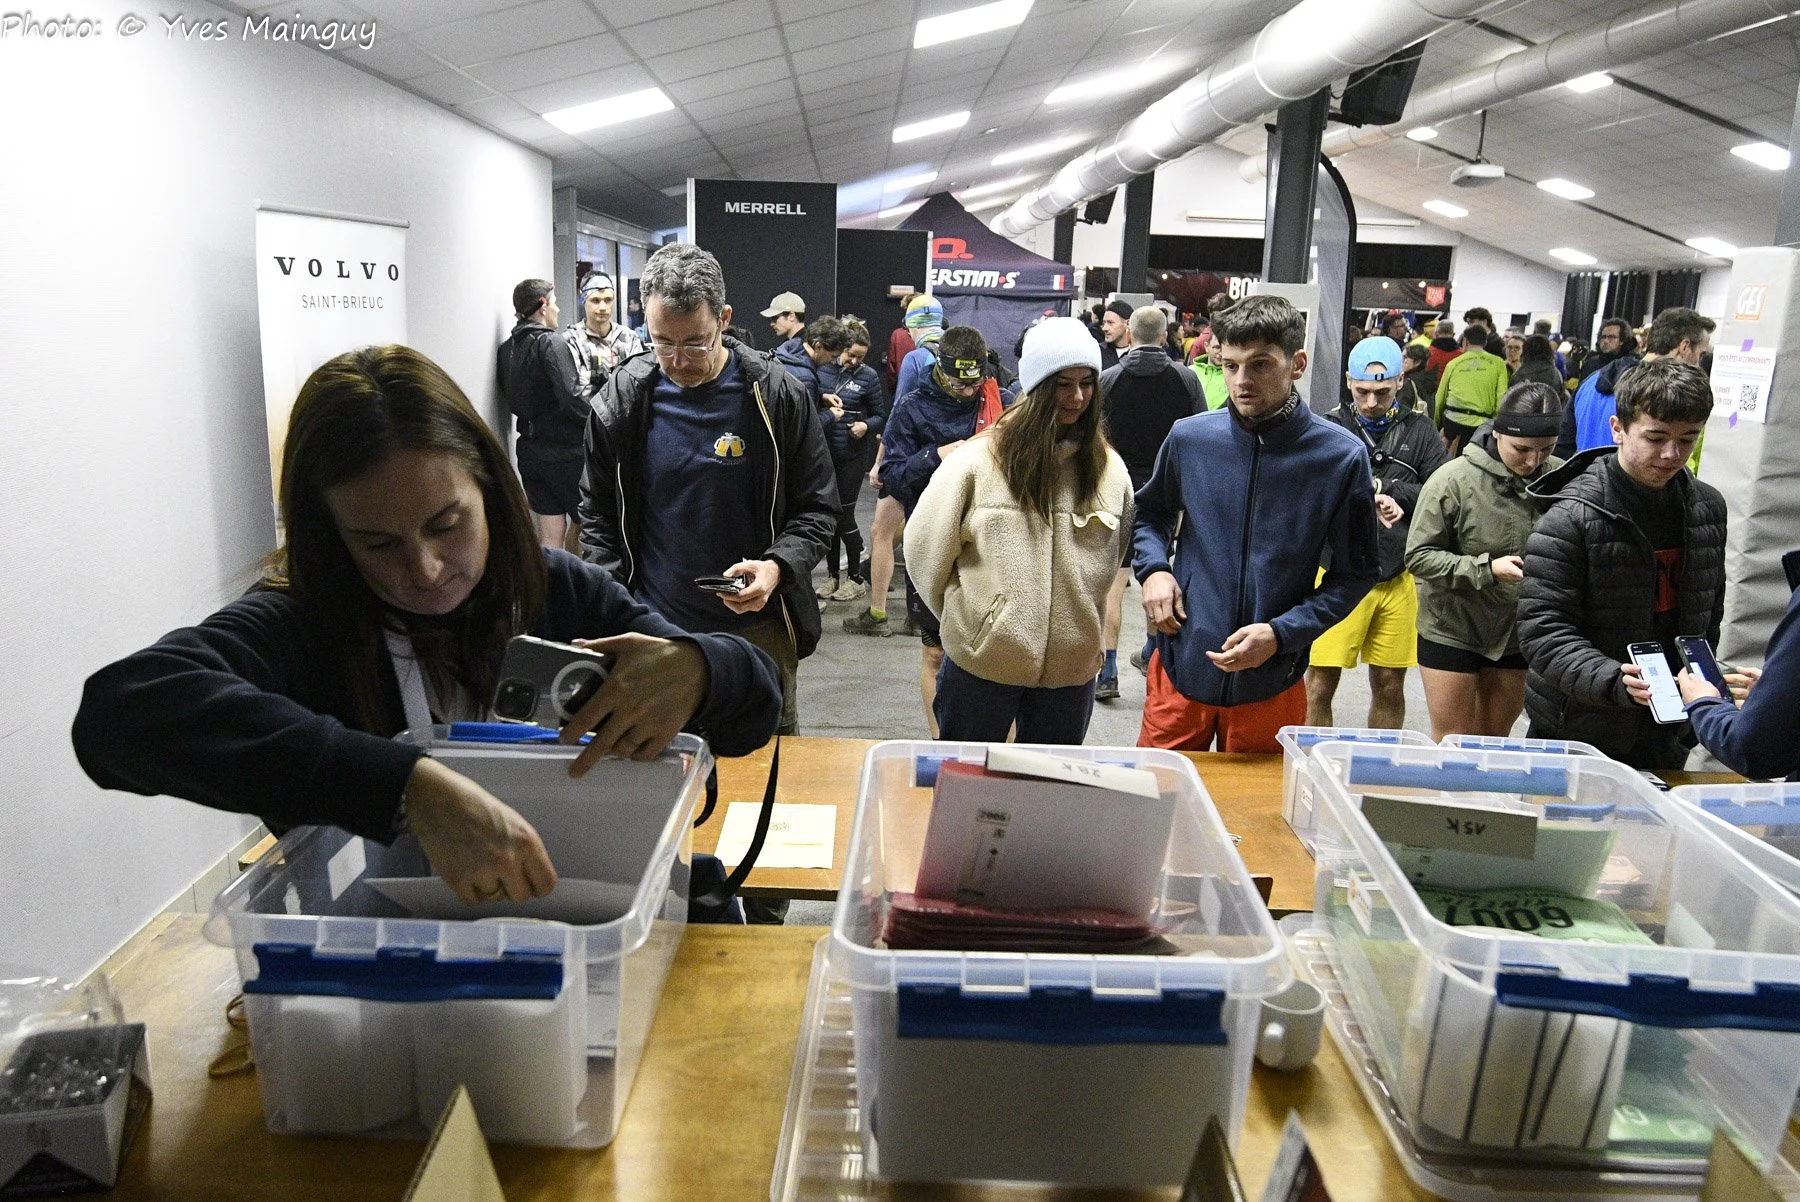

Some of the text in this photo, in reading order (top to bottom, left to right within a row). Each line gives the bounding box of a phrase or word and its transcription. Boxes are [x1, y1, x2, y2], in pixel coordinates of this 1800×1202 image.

[725, 201, 807, 216] MERRELL
[273, 256, 400, 282] VOLVO
[301, 294, 385, 310] SAINT-BRIEUC
